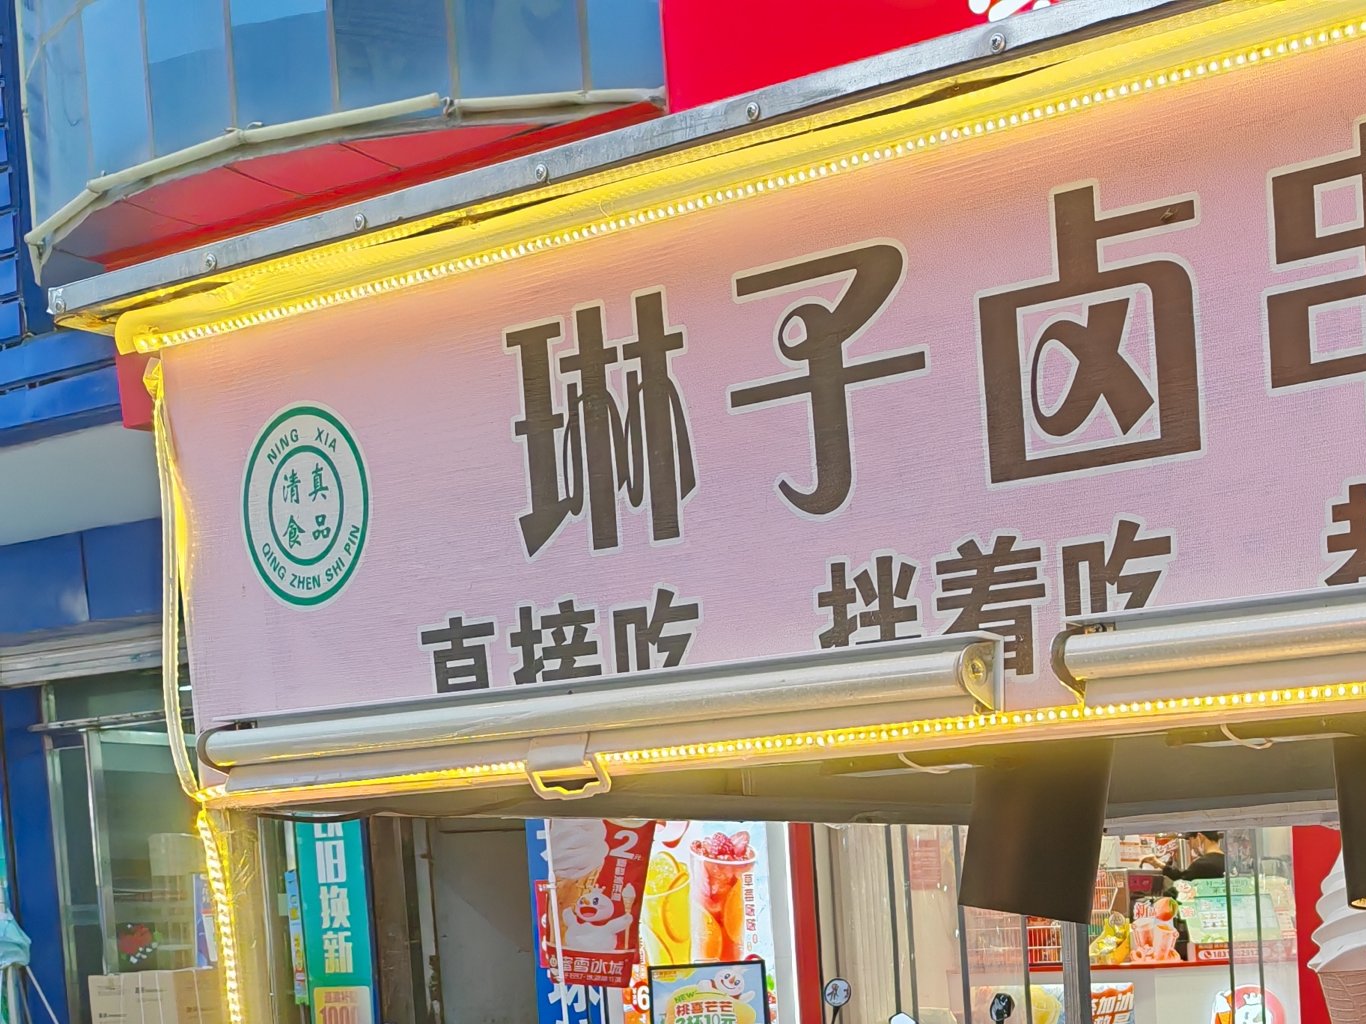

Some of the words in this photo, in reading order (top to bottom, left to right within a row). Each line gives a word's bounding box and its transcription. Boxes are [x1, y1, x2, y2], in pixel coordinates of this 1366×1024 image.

[267, 428, 299, 464] NING
[315, 428, 337, 452] XIA
[282, 463, 329, 504] 清真
[283, 514, 331, 549] 食品
[262, 542, 287, 581] QING
[289, 573, 321, 591] ZHEN
[325, 557, 346, 582] SHI
[343, 524, 360, 556] PIN
[674, 990, 696, 1003] NEW
